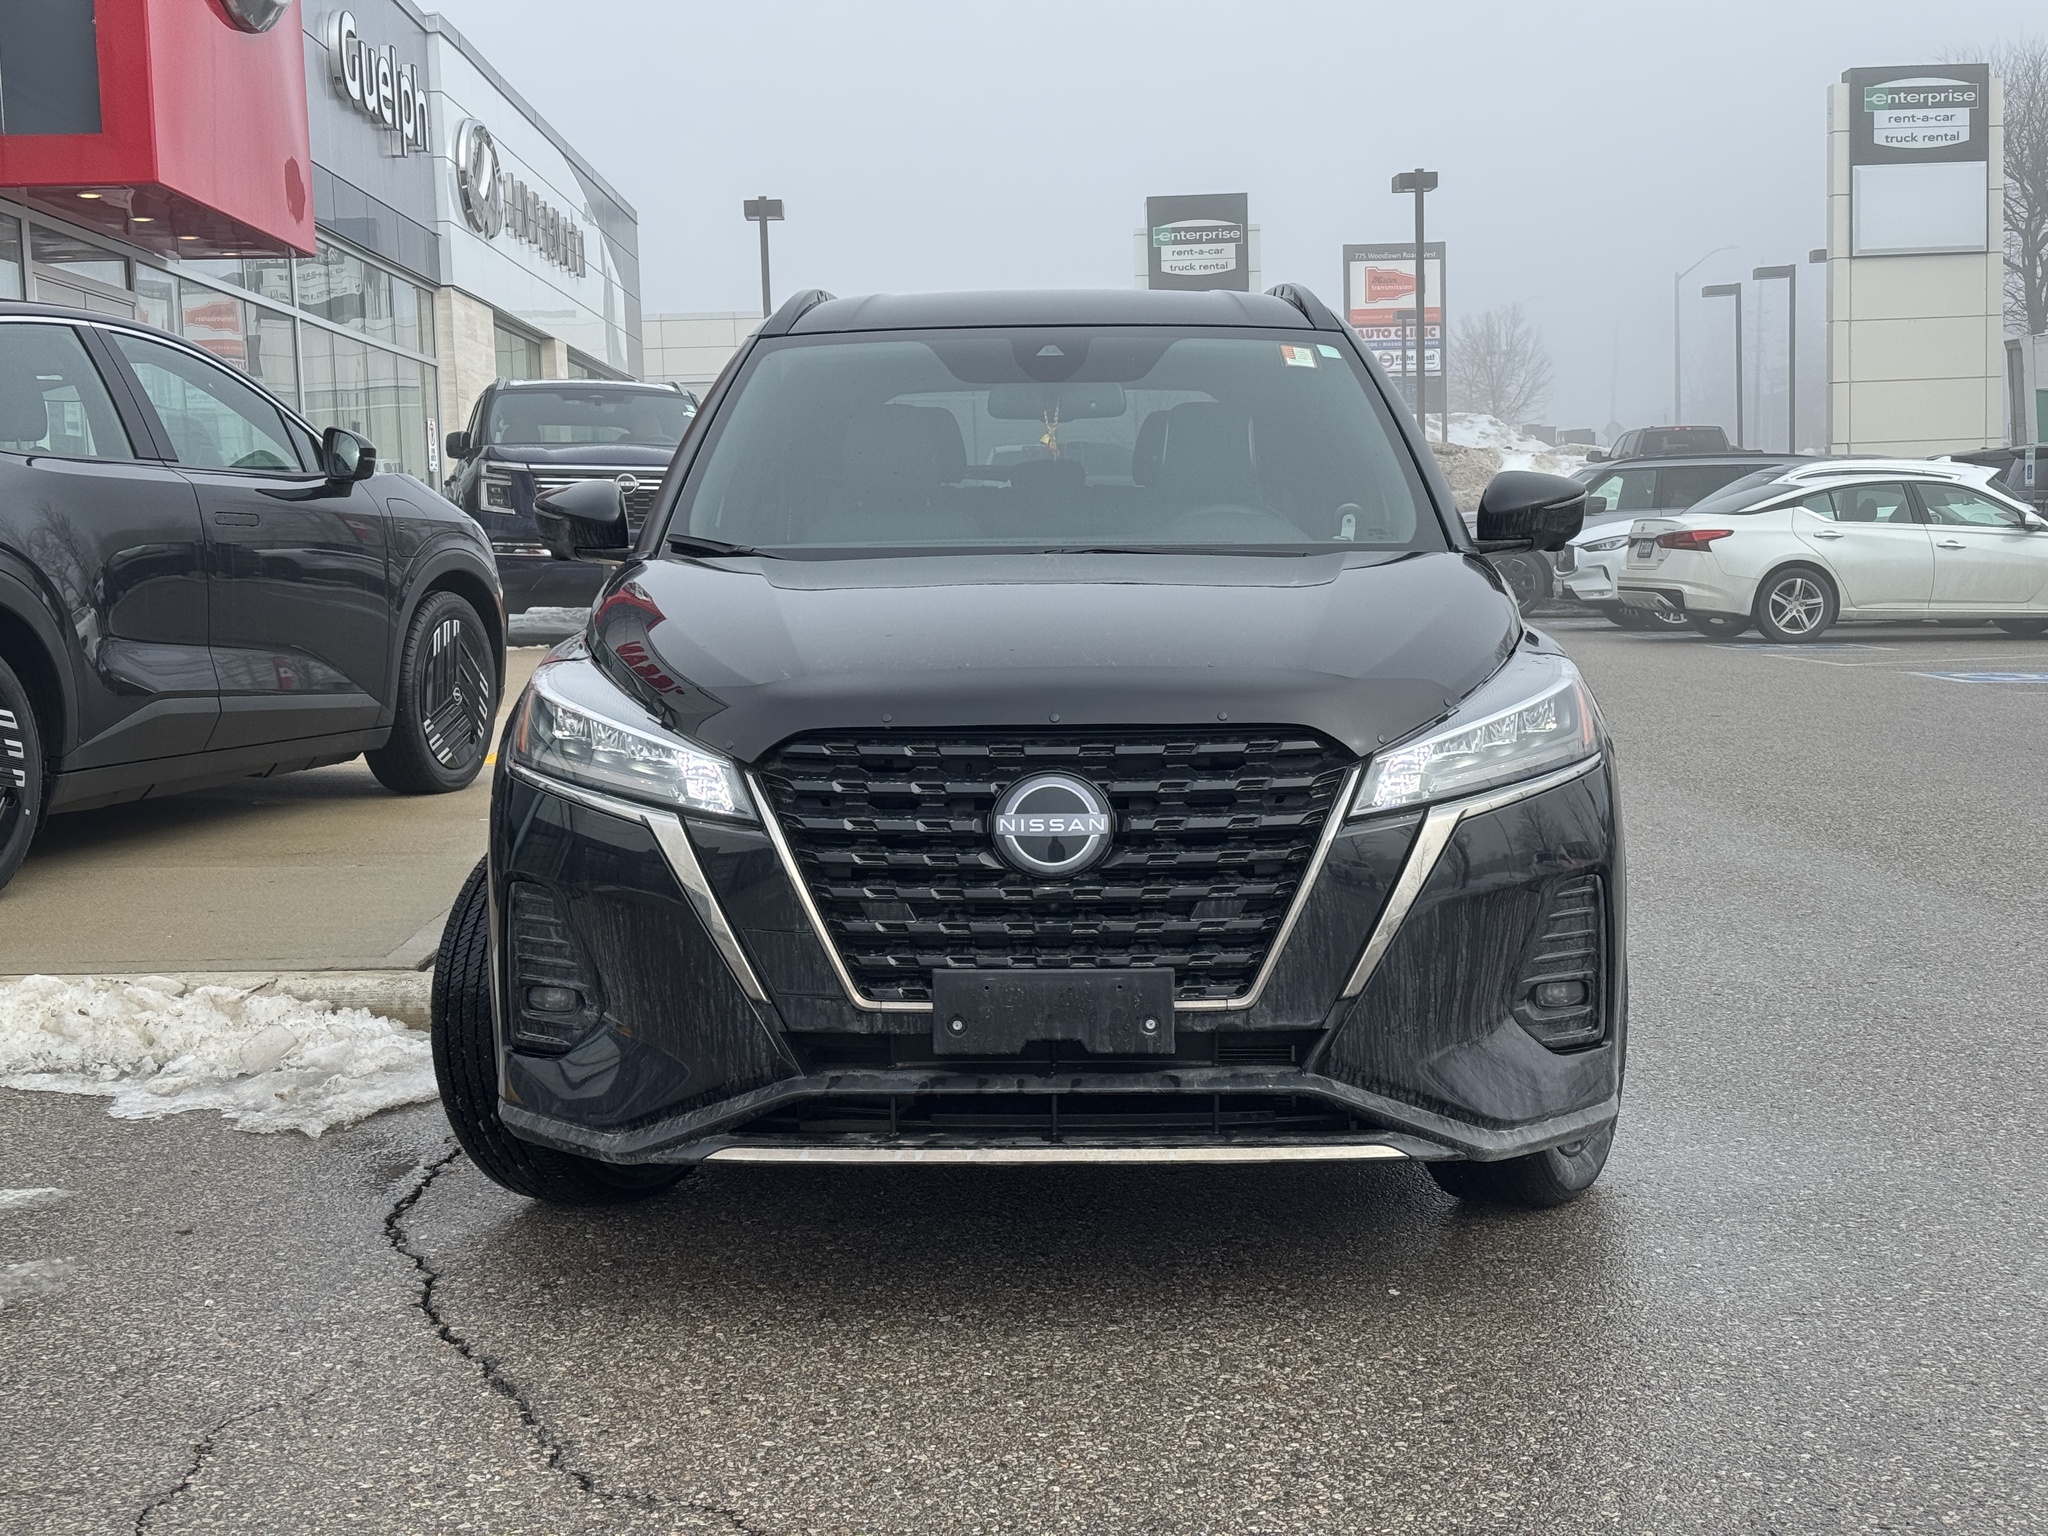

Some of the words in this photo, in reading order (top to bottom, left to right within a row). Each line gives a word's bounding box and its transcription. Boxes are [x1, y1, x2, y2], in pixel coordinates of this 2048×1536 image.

[333, 10, 431, 158] Guelph
[1867, 88, 1977, 106] enterprise
[1888, 112, 1956, 123] rent-a-car
[1884, 132, 1918, 143] truck
[1922, 131, 1960, 142] rental
[1156, 228, 1240, 242] enterprise
[1171, 247, 1225, 256] rent-a-car
[1169, 262, 1196, 272] truck
[1198, 261, 1228, 271] rental
[1357, 328, 1392, 339] AUTO
[999, 817, 1105, 832] NISSAN
